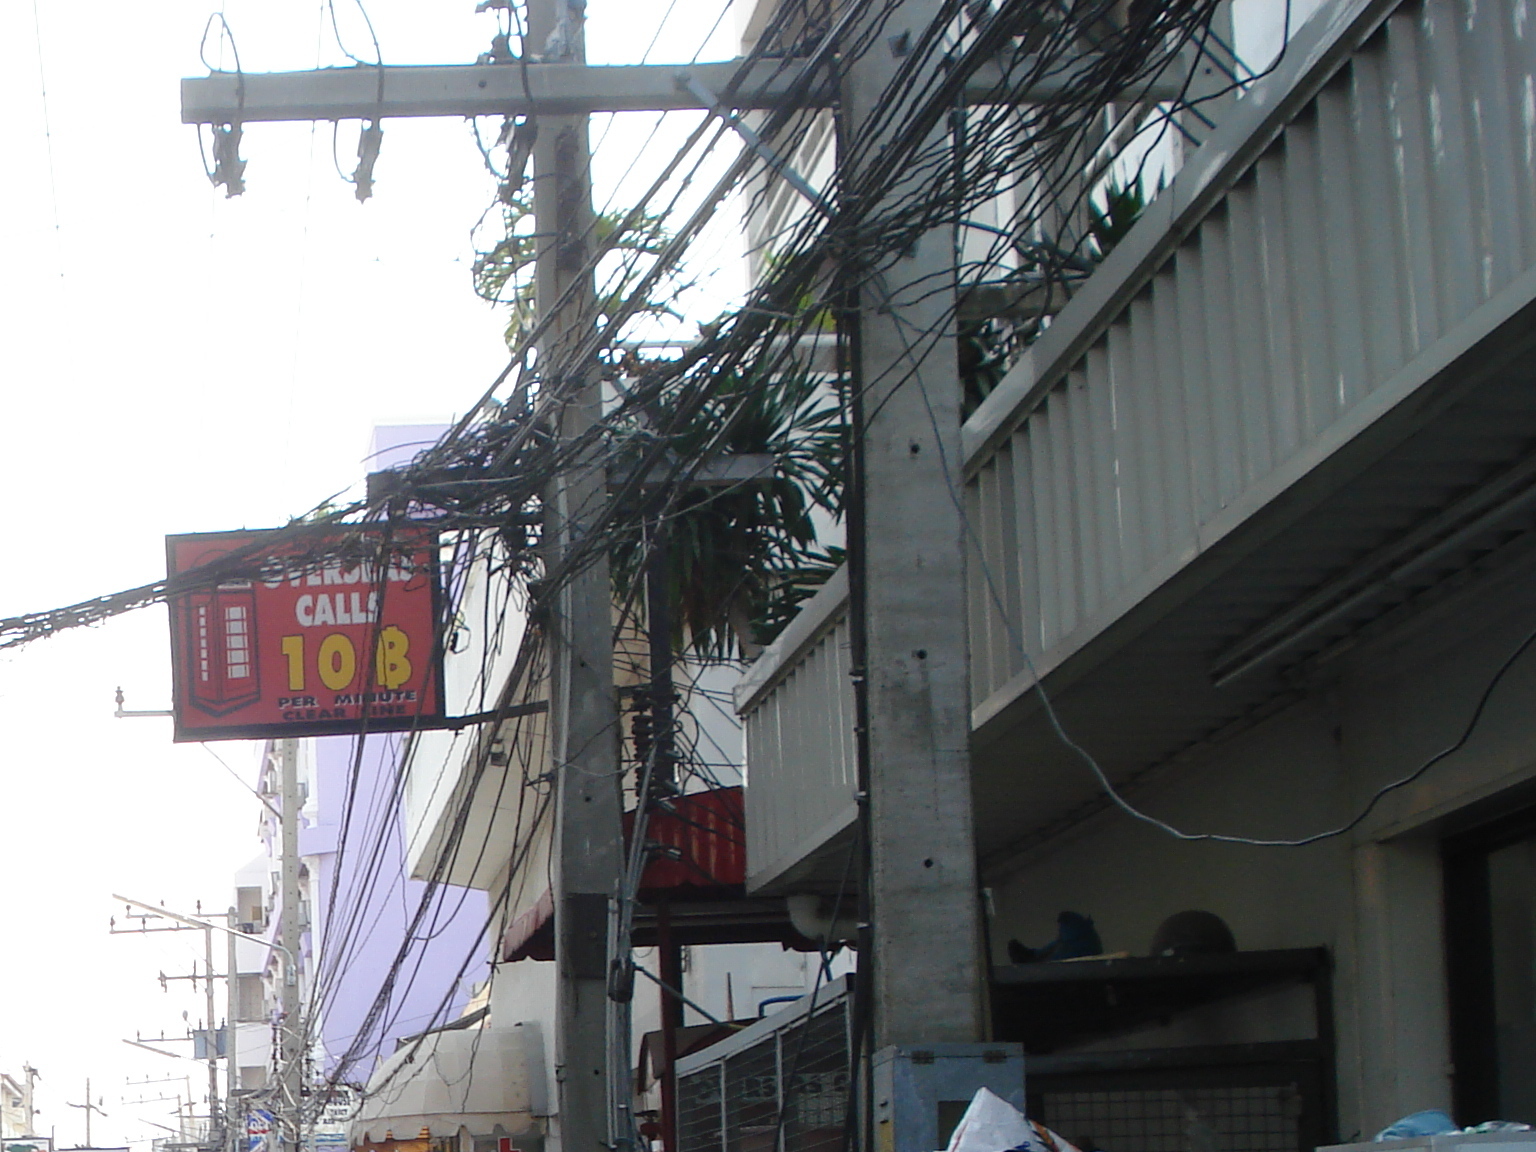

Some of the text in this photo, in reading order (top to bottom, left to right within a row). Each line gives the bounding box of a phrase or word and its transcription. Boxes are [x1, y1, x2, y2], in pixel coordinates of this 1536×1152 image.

[278, 696, 319, 709] PER
[282, 704, 406, 720] CLEAR INE
